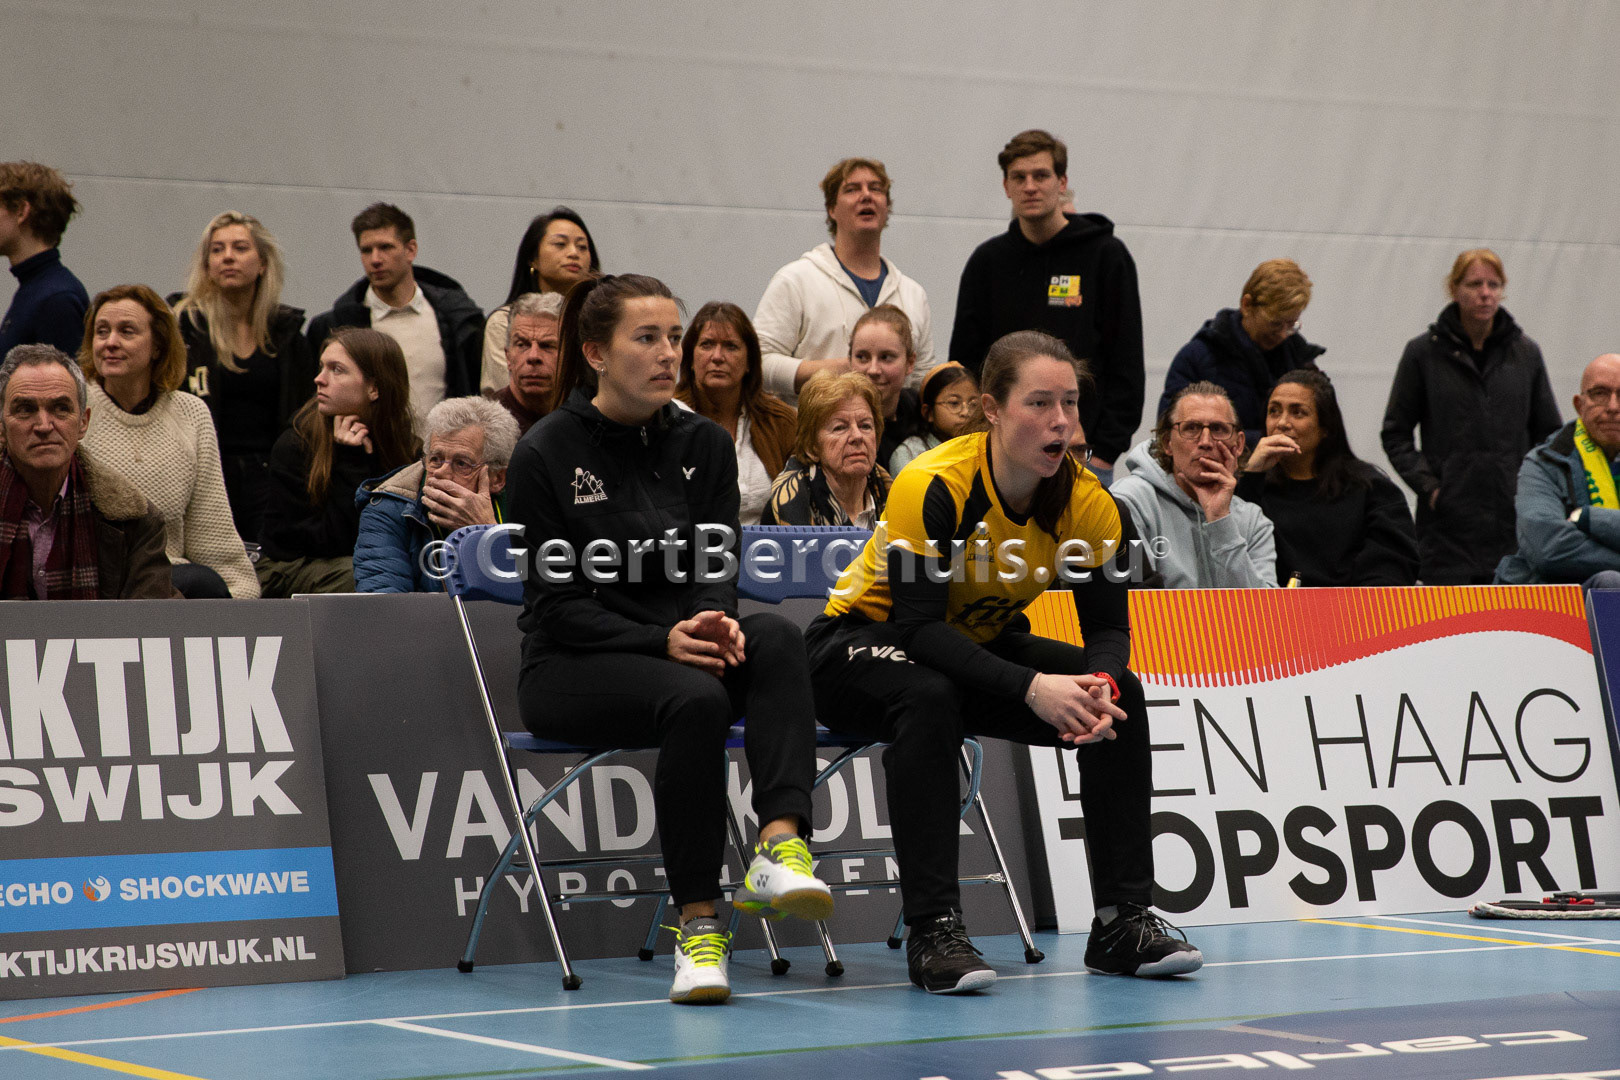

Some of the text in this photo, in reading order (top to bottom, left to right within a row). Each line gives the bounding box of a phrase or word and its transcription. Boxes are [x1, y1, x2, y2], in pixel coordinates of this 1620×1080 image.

[574, 493, 608, 504] ALMERE
[0, 636, 295, 760] KTIJK
[1304, 687, 1591, 791] HAAG
[0, 870, 310, 907] CHO SHOCKWAVE
